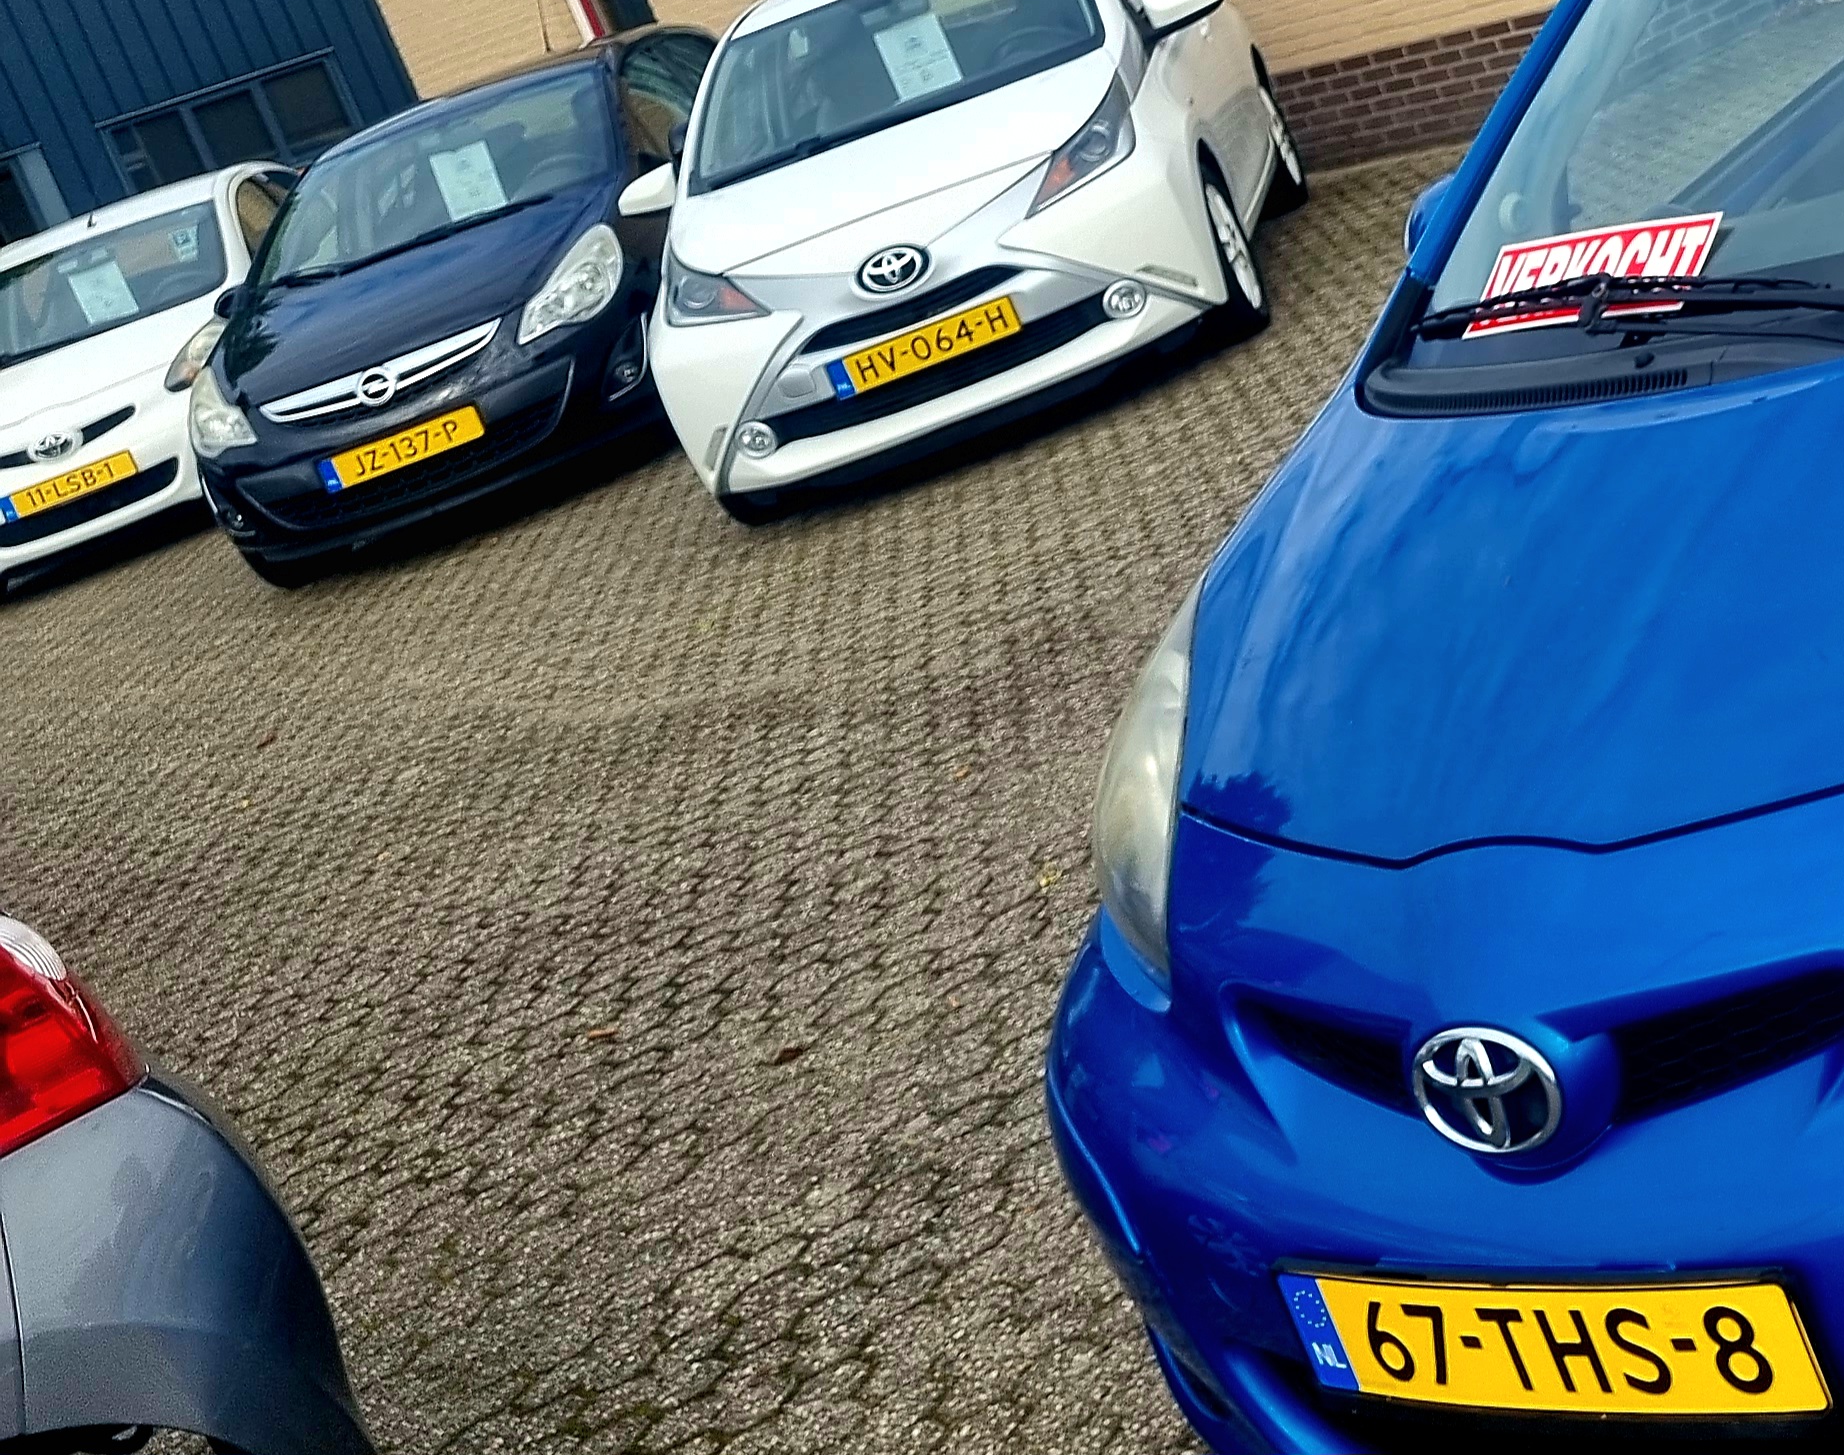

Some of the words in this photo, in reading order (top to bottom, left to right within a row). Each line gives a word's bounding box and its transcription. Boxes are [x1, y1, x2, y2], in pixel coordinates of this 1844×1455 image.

[856, 305, 1009, 383] HV-064-H
[355, 419, 458, 476] JZ-137-P
[26, 462, 114, 507] 11-LSB-1
[1311, 1342, 1347, 1368] NL
[1367, 1301, 1775, 1395] 67-THS-8
